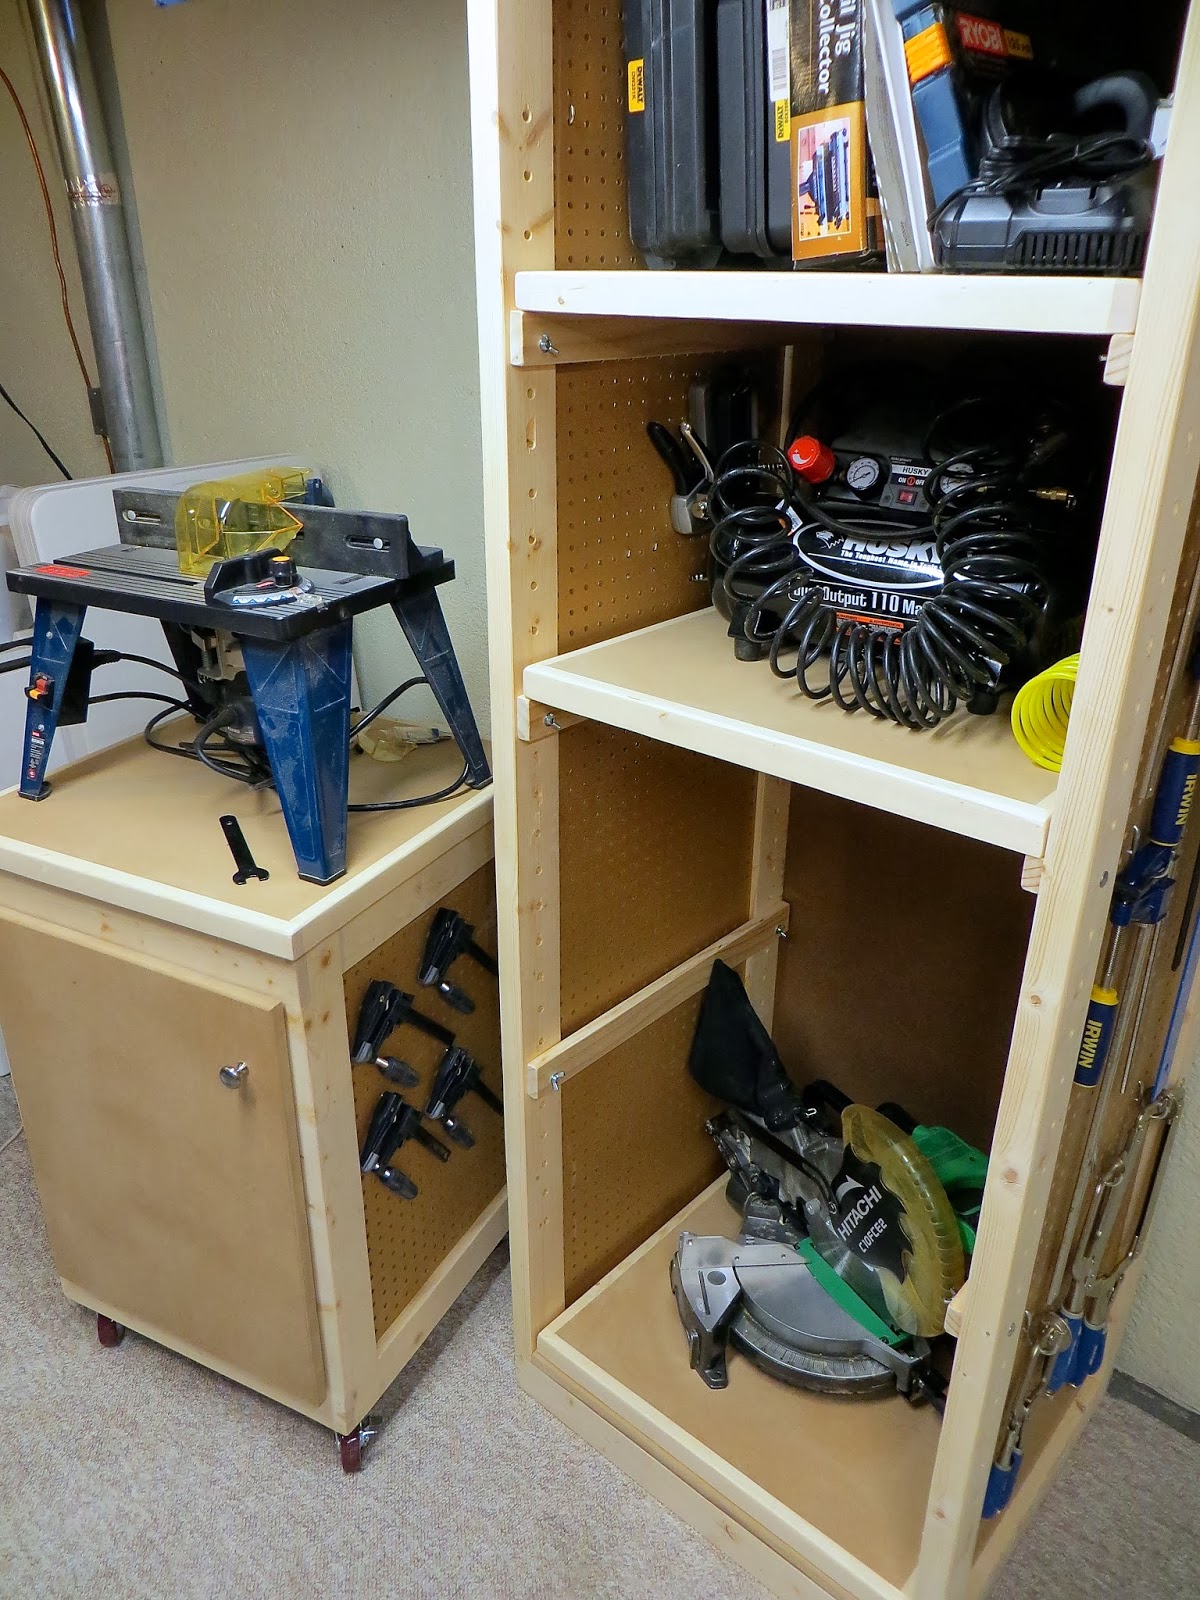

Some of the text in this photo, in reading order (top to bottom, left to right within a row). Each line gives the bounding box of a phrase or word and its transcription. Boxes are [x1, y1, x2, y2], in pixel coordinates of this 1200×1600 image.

[835, 22, 856, 57] Jig
[959, 17, 1004, 52] RYOBI
[897, 476, 925, 486] ON OFF
[902, 466, 929, 476] HUSKY
[841, 550, 853, 558] The
[855, 552, 886, 563] Toughest
[823, 586, 867, 608] Output
[871, 592, 900, 613] 110
[902, 600, 923, 616] Ma
[1175, 774, 1197, 825] IRWIN
[1078, 1019, 1103, 1069] IRWIN
[837, 1185, 882, 1241] HITACHI
[858, 1217, 888, 1253] C10FCE2
